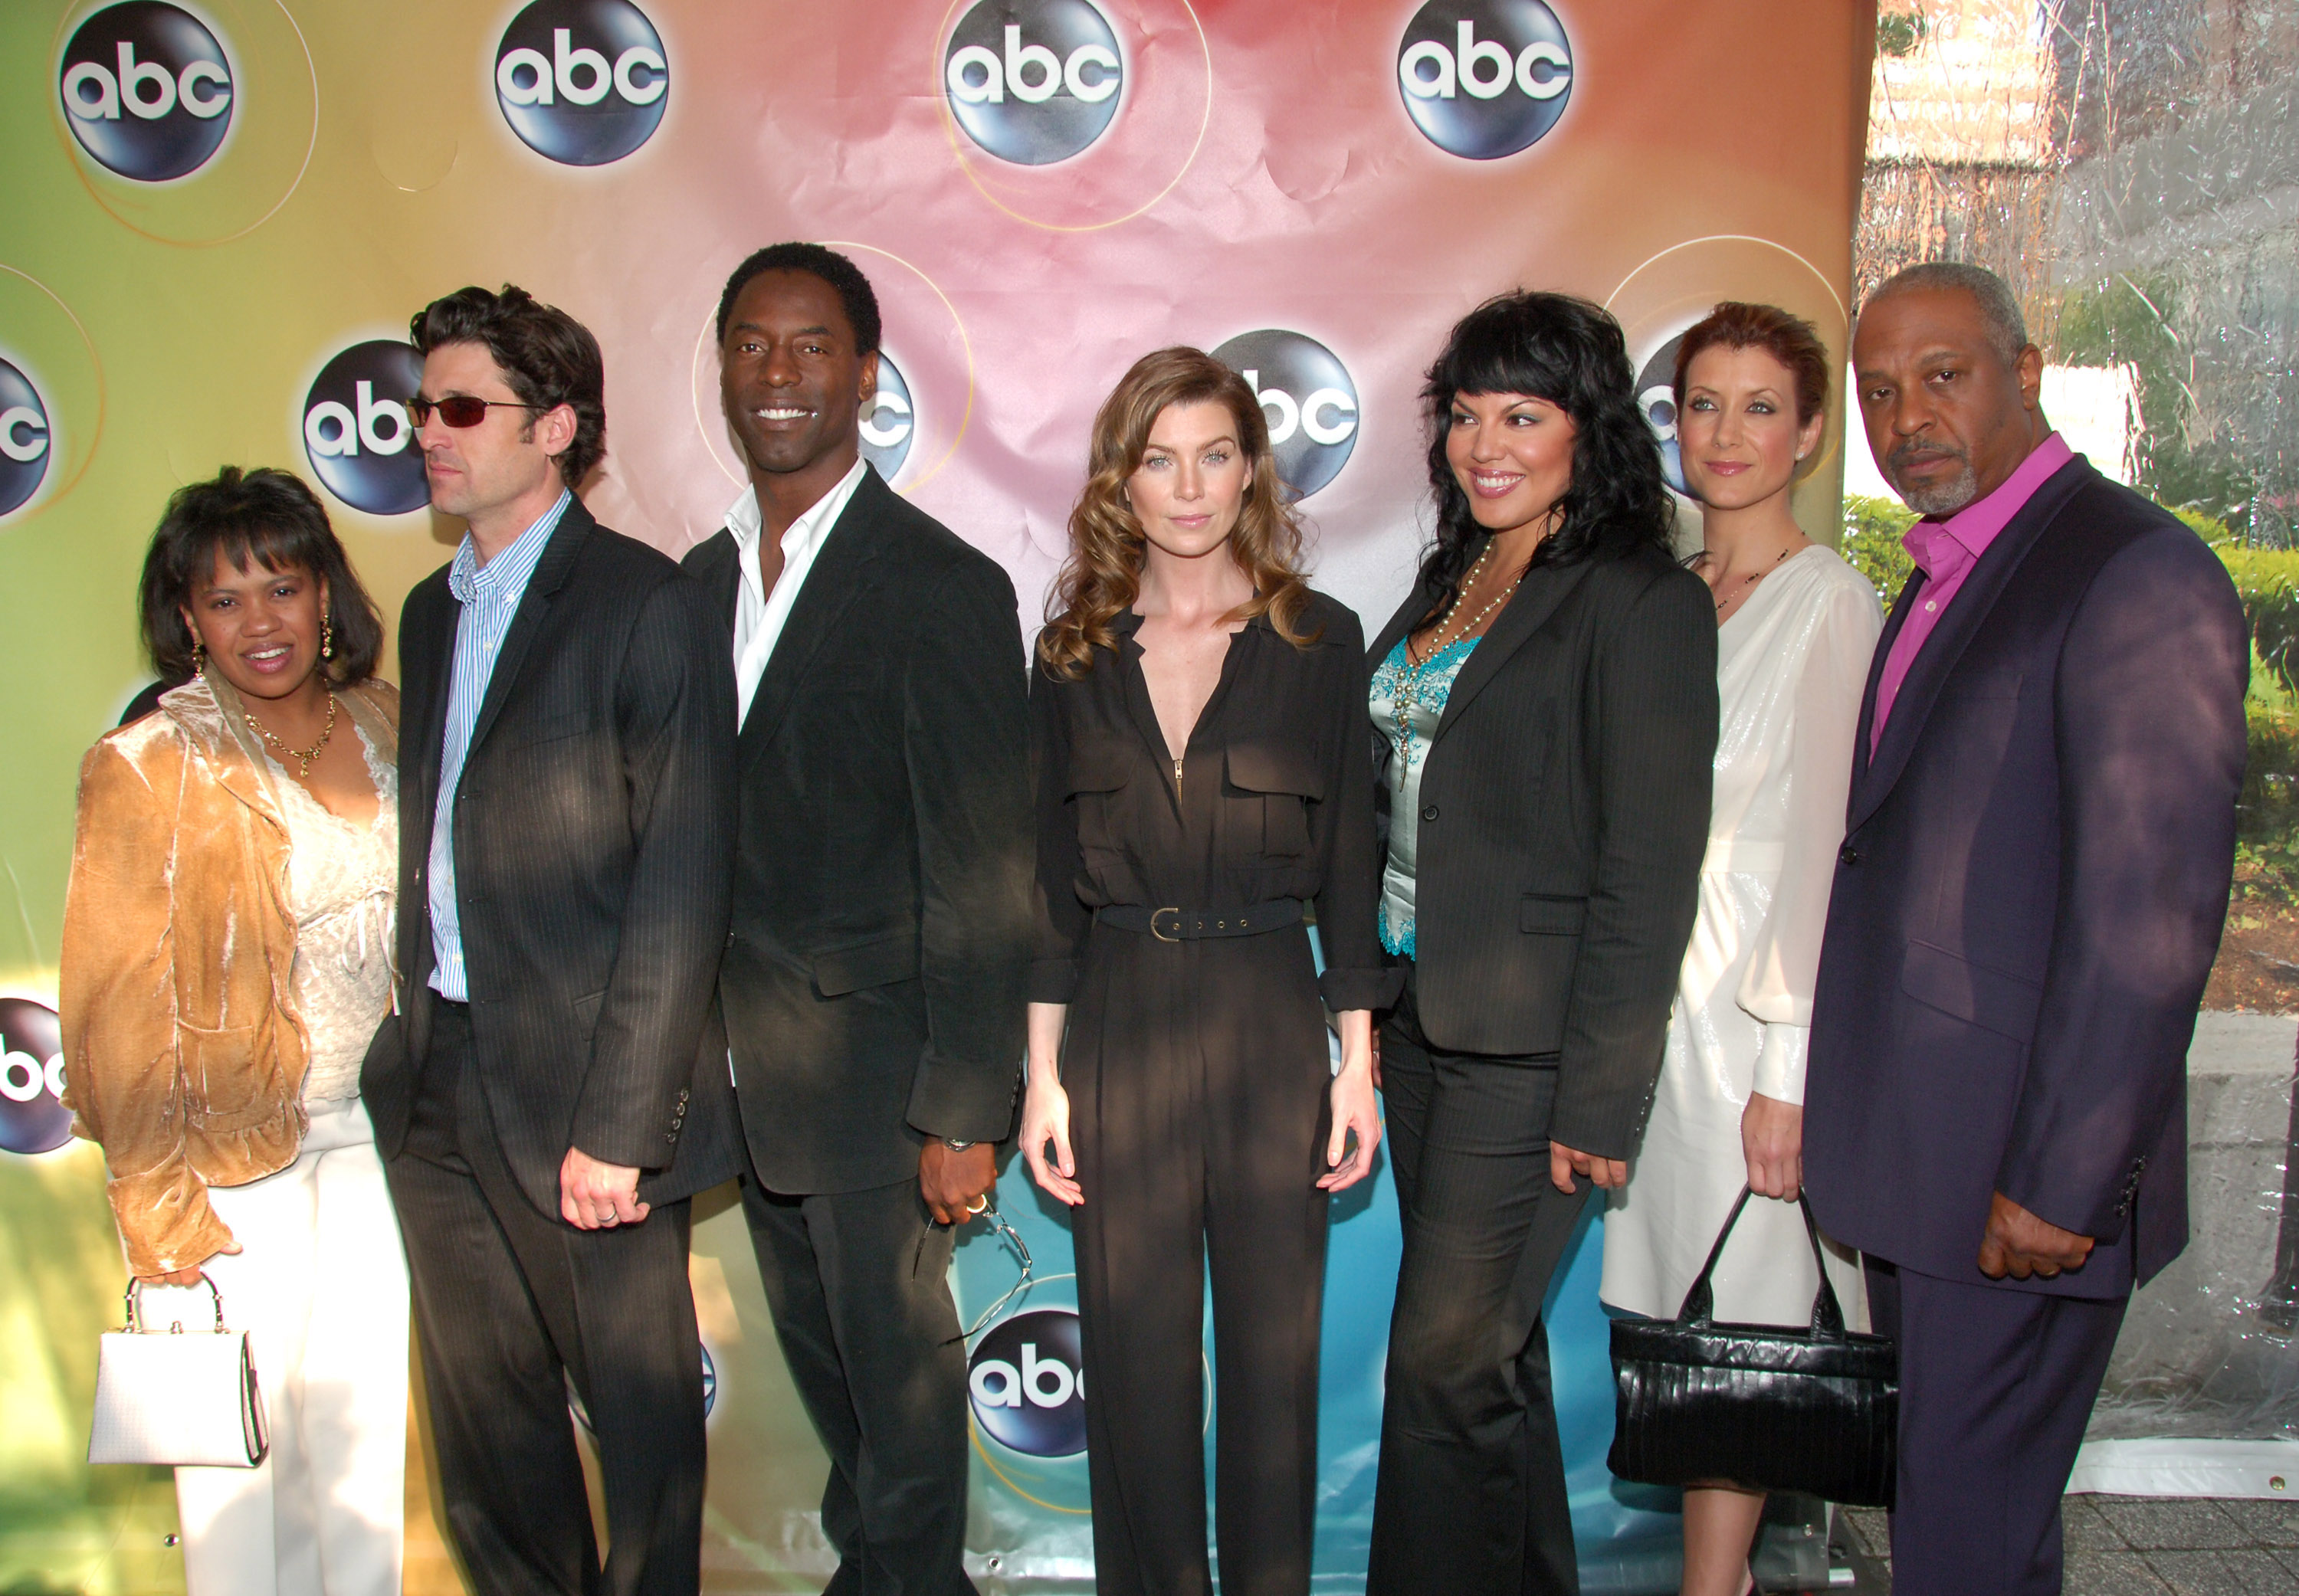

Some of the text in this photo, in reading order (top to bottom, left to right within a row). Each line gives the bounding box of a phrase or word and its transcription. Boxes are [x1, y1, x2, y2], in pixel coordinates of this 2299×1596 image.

[63, 41, 231, 120] abc
[497, 28, 667, 105] abc
[947, 25, 1120, 103] abc
[1399, 20, 1571, 99] abc
[305, 380, 425, 456] ab
[1243, 369, 1356, 445] bc
[969, 1344, 1084, 1408] ab
